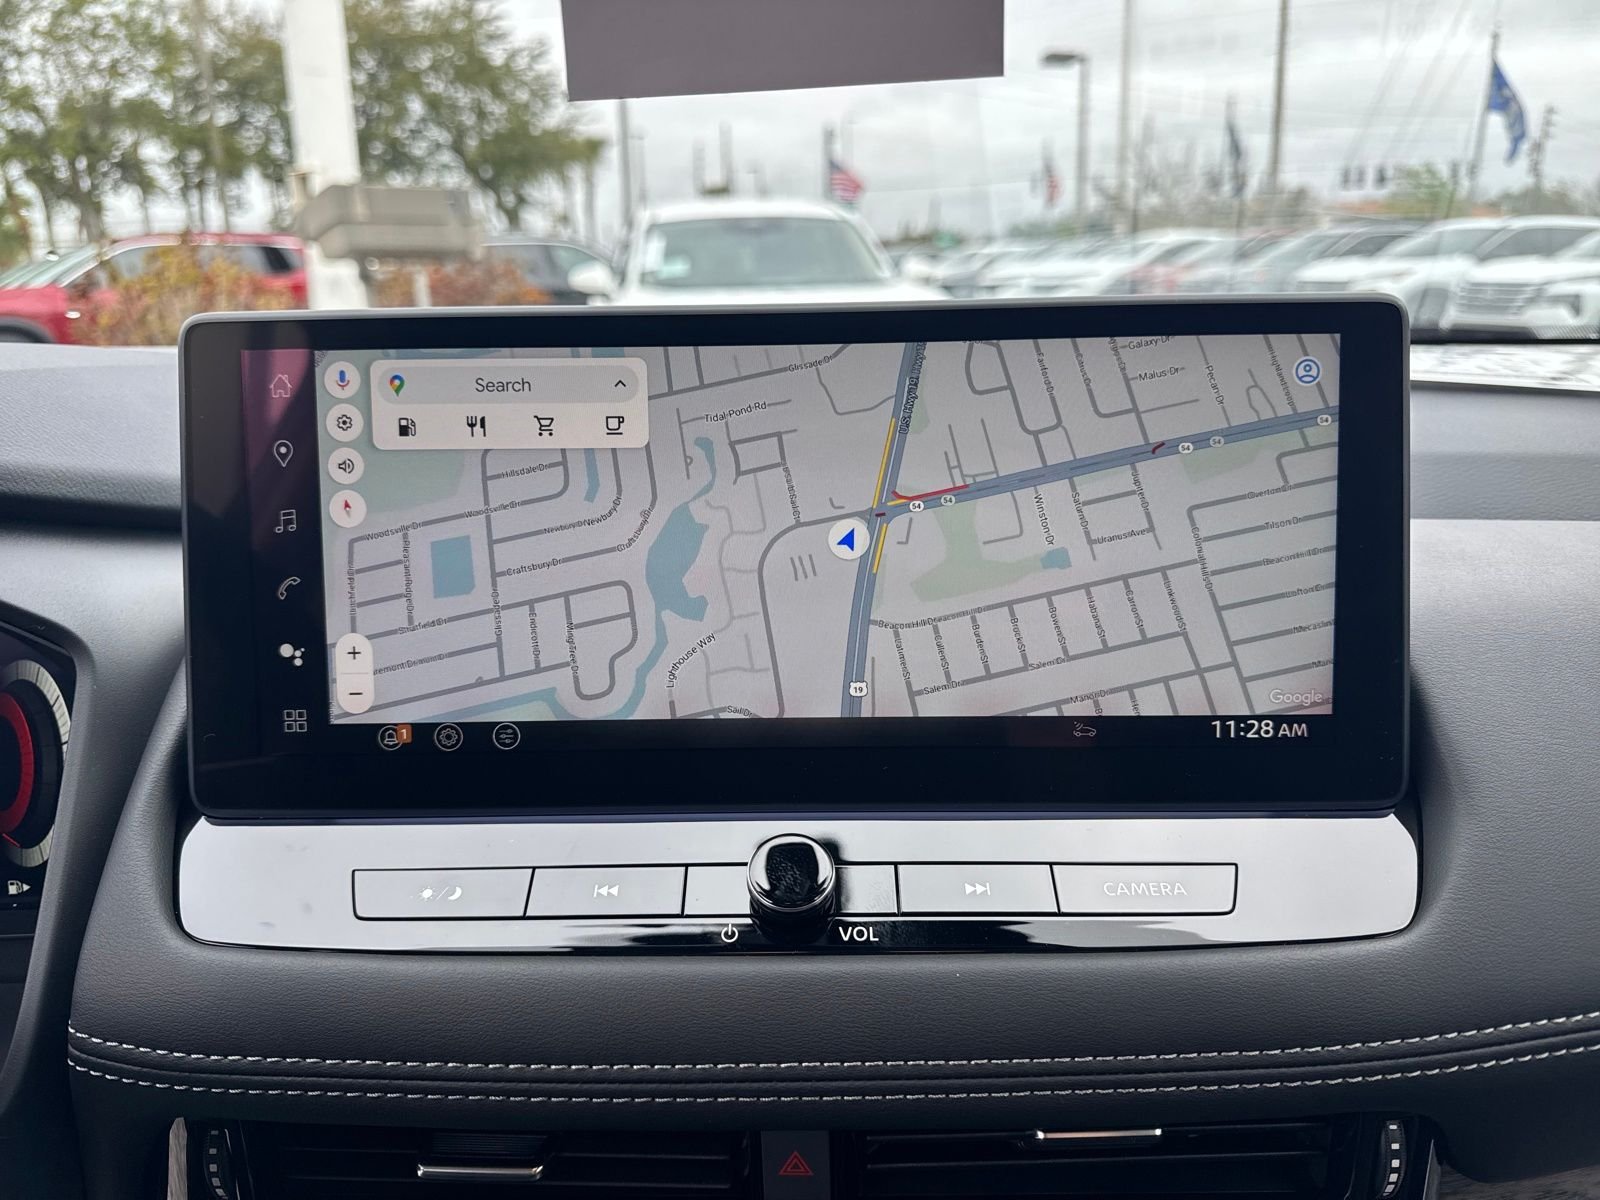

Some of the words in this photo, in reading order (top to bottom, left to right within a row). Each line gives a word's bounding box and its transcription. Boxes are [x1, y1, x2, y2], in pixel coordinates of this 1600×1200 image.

[1128, 338, 1160, 349] Galaxy
[788, 357, 824, 372] Glissade
[1138, 370, 1167, 381] Malus
[1169, 367, 1179, 375] Dr
[474, 377, 532, 394] Search
[1206, 365, 1220, 393] Pecan
[1215, 393, 1225, 406] Dr
[705, 410, 727, 423] Tidal
[728, 405, 752, 419] Pond
[754, 401, 767, 411] Rd
[1319, 416, 1329, 424] 54
[502, 464, 538, 479] Hillsdale
[943, 496, 953, 504] 54
[1132, 472, 1146, 502] Jupiter
[1141, 502, 1150, 512] Dr
[464, 503, 510, 518] Woodsville
[584, 504, 618, 527] Newbury
[911, 502, 921, 511] 54
[1071, 492, 1086, 519] Saturn
[1081, 519, 1090, 530] Dr
[1035, 494, 1052, 532] Winston
[1045, 533, 1054, 546] Dr
[1292, 516, 1302, 524] Dr
[365, 525, 410, 541] Woodsville
[1097, 532, 1128, 544] Uranus
[1128, 528, 1147, 540] Ave
[1192, 526, 1206, 561] Colonial
[402, 541, 411, 577] Pleasant
[506, 560, 550, 577] Craftsbury
[550, 557, 562, 568] Dr
[405, 579, 413, 605] Ridge
[1126, 589, 1139, 617] Carron
[1135, 617, 1144, 629] St
[1164, 580, 1182, 622] Linkwood
[1178, 622, 1187, 633] St
[492, 600, 503, 636] Glissade
[878, 620, 911, 630] Beacon
[1049, 607, 1063, 635] Bowen
[1057, 635, 1067, 647] St
[1087, 596, 1104, 627] Habana
[1097, 627, 1106, 640] St
[529, 612, 540, 647] Endicott
[566, 622, 577, 643] Ming
[1010, 617, 1023, 643] Brock
[1017, 643, 1026, 653] St
[569, 644, 577, 664] Tree
[934, 635, 947, 660] Cullen
[941, 660, 949, 671] St
[972, 624, 986, 654] Burden
[980, 654, 989, 665] St
[666, 646, 698, 688] Lighthouse
[697, 632, 716, 651] Way
[896, 638, 908, 670] Latimer
[902, 670, 911, 681] St
[1030, 660, 1055, 671] Salem
[853, 685, 863, 694] 19
[923, 683, 950, 695] Salem
[951, 680, 962, 689] Dr
[1269, 689, 1322, 706] Google
[401, 729, 408, 740] 1
[1211, 720, 1273, 739] 11:28
[1277, 723, 1308, 737] AM
[1103, 881, 1188, 897] CAMERA
[838, 926, 880, 942] VOL
